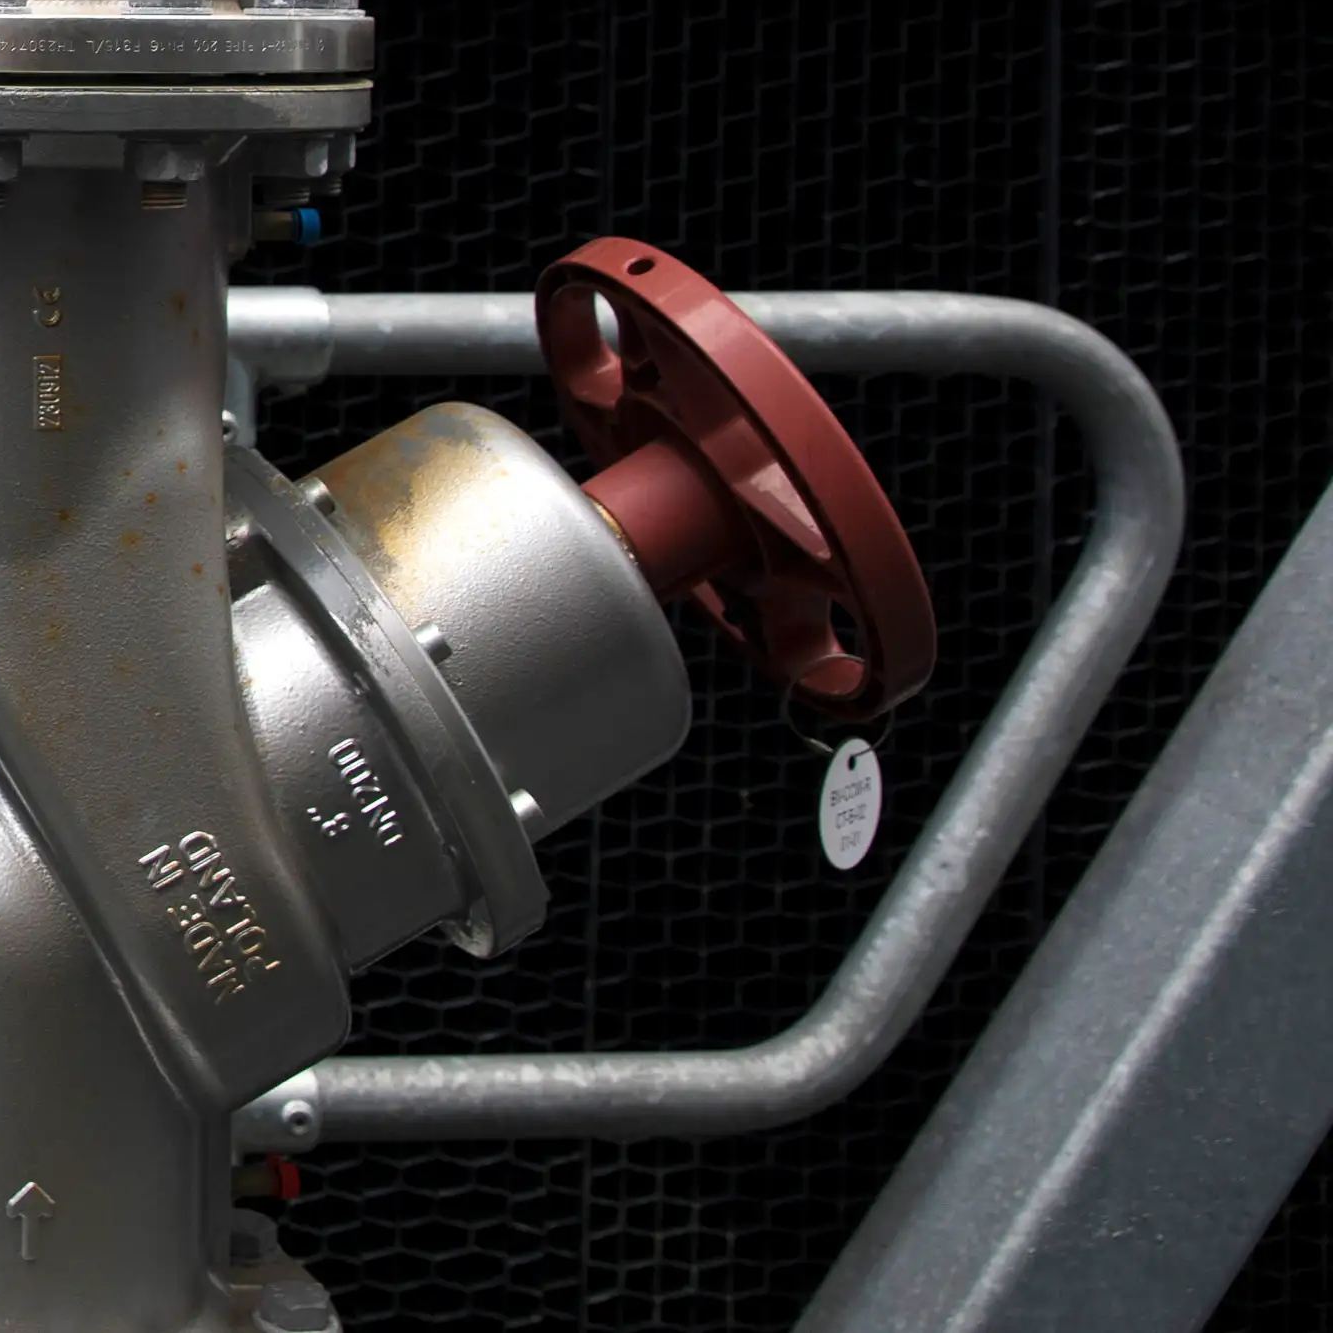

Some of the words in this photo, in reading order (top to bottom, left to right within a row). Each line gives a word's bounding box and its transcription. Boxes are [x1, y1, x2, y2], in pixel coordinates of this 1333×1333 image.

[328, 738, 402, 846] DN200
[138, 844, 183, 889] IN
[178, 831, 282, 982] POLAND
[167, 893, 246, 1005] MADE
